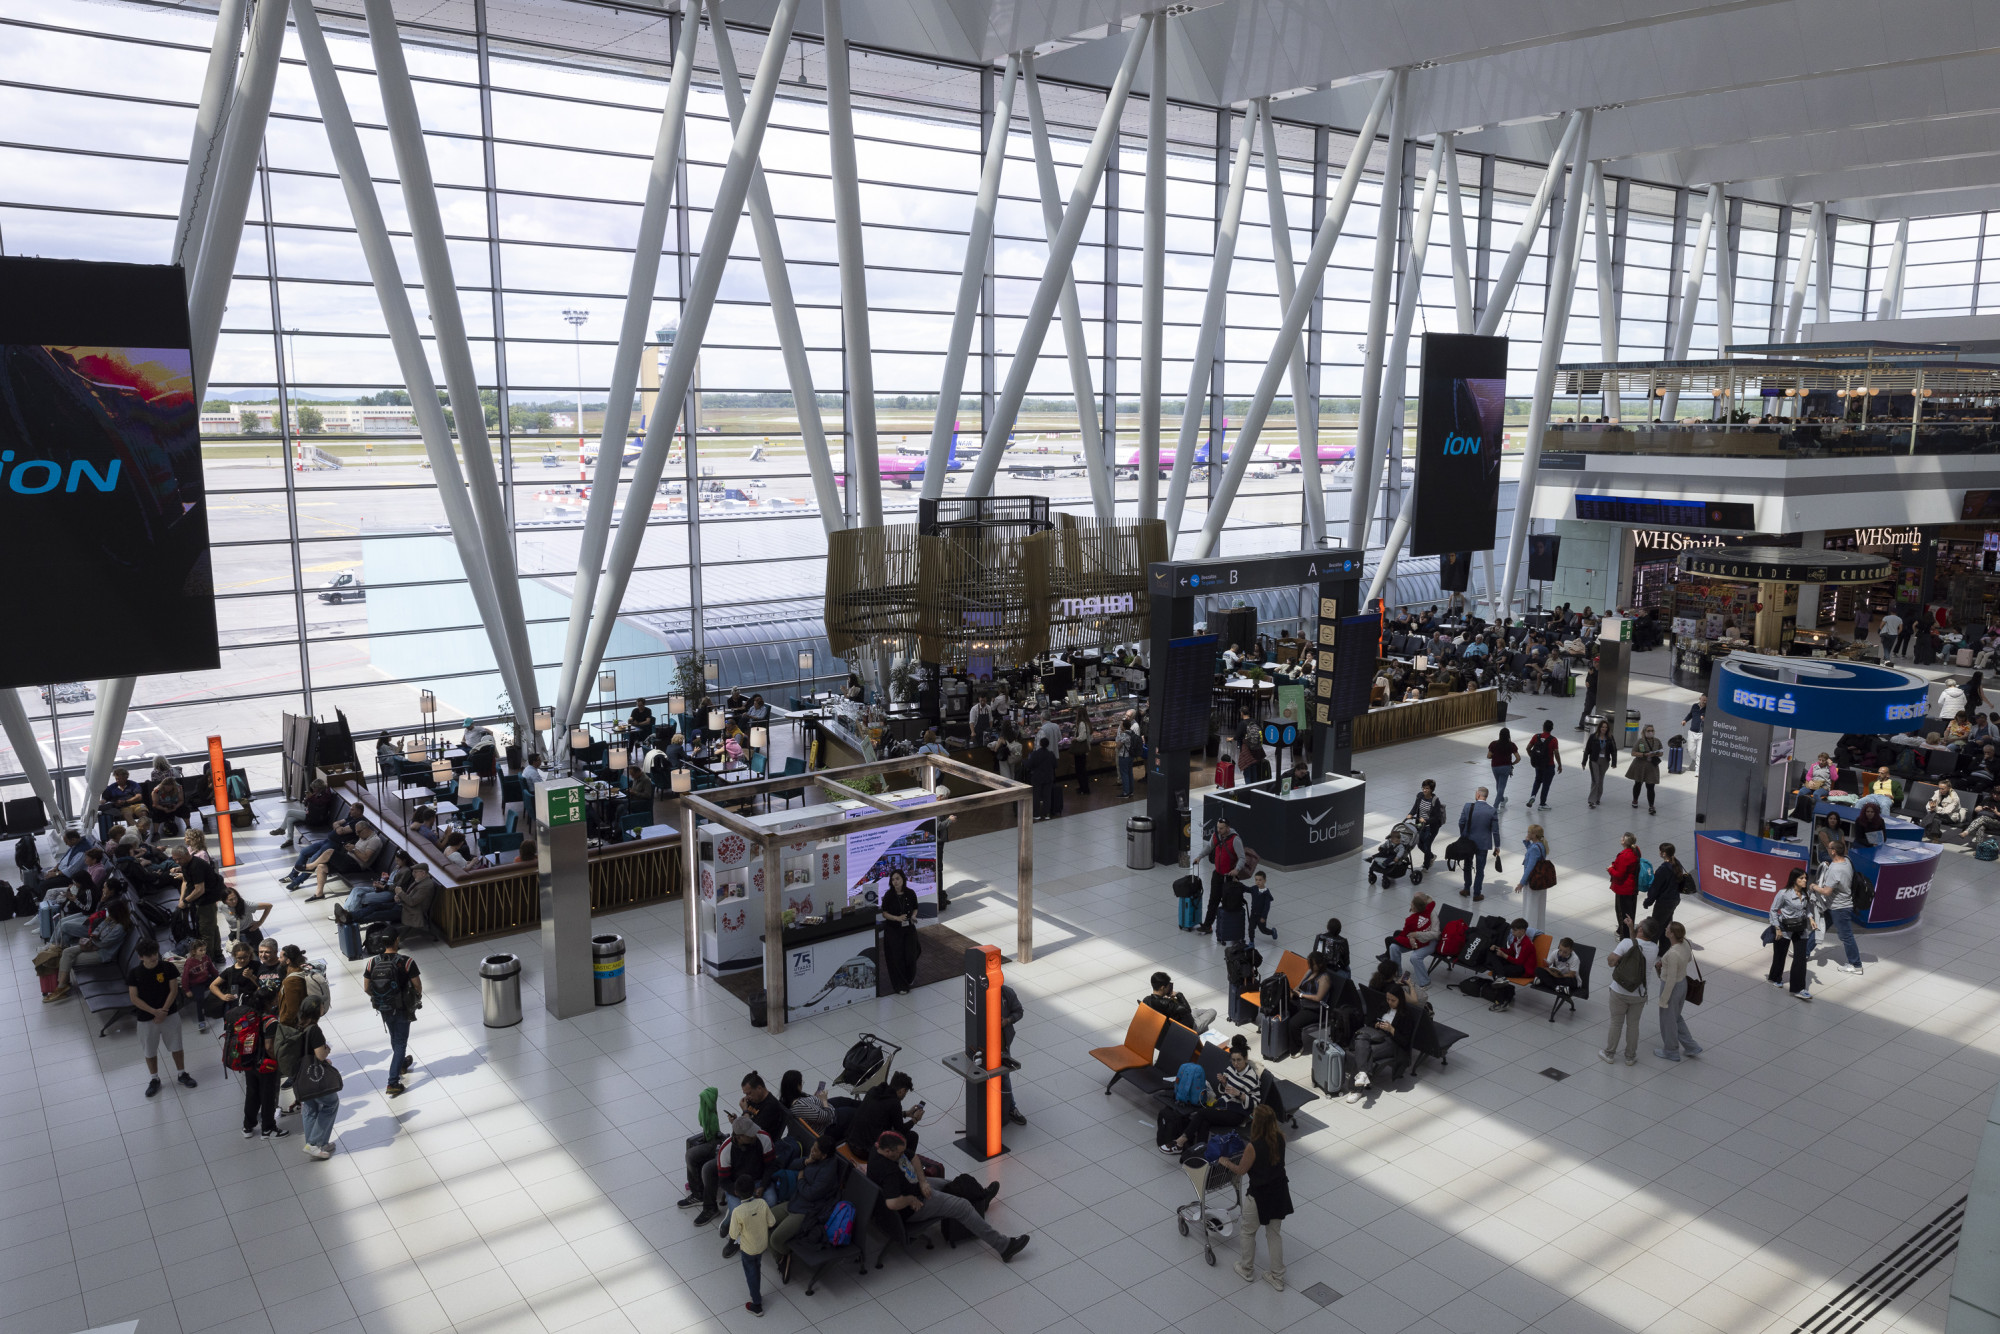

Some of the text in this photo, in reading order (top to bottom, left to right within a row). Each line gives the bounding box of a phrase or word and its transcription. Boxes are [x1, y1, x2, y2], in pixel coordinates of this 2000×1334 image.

[1631, 529, 1727, 551] WHSmith
[1855, 525, 1923, 547] WHSmith
[1229, 569, 1238, 584] B
[1308, 562, 1318, 577] A
[1692, 560, 1792, 579] CSOKOLÁDÉ
[1733, 689, 1776, 712] ERSTE
[1712, 720, 1737, 731] Believe
[1710, 746, 1759, 764] in you already.
[1711, 737, 1758, 754] Erste believes
[1308, 821, 1337, 844] bud
[1713, 864, 1757, 890] ERSTE
[1895, 881, 1928, 900] ERSTE
[1464, 937, 1482, 961] adidas
[793, 952, 811, 968] 75
